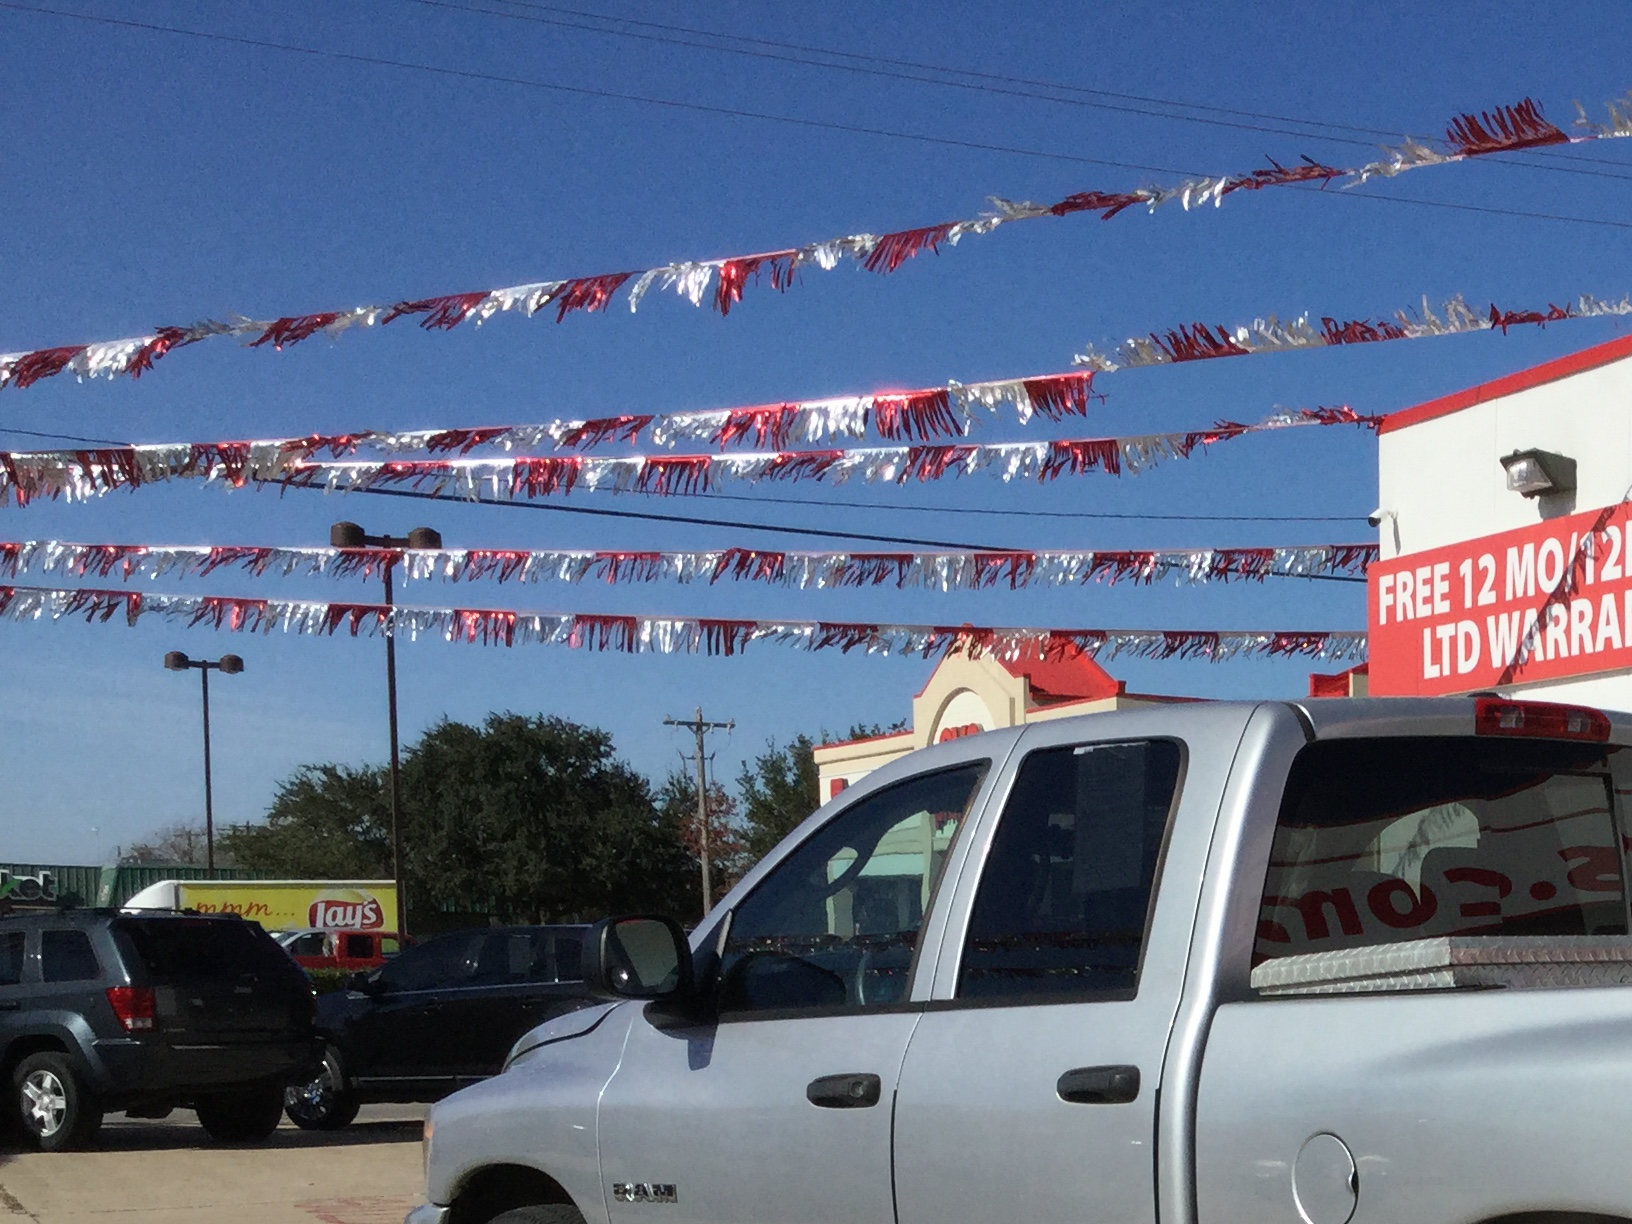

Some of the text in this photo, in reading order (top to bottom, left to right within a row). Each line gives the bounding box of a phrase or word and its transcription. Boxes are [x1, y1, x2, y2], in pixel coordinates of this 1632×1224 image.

[1379, 561, 1450, 625] FREE
[1459, 553, 1497, 609] 12
[1423, 619, 1481, 680] LTD
